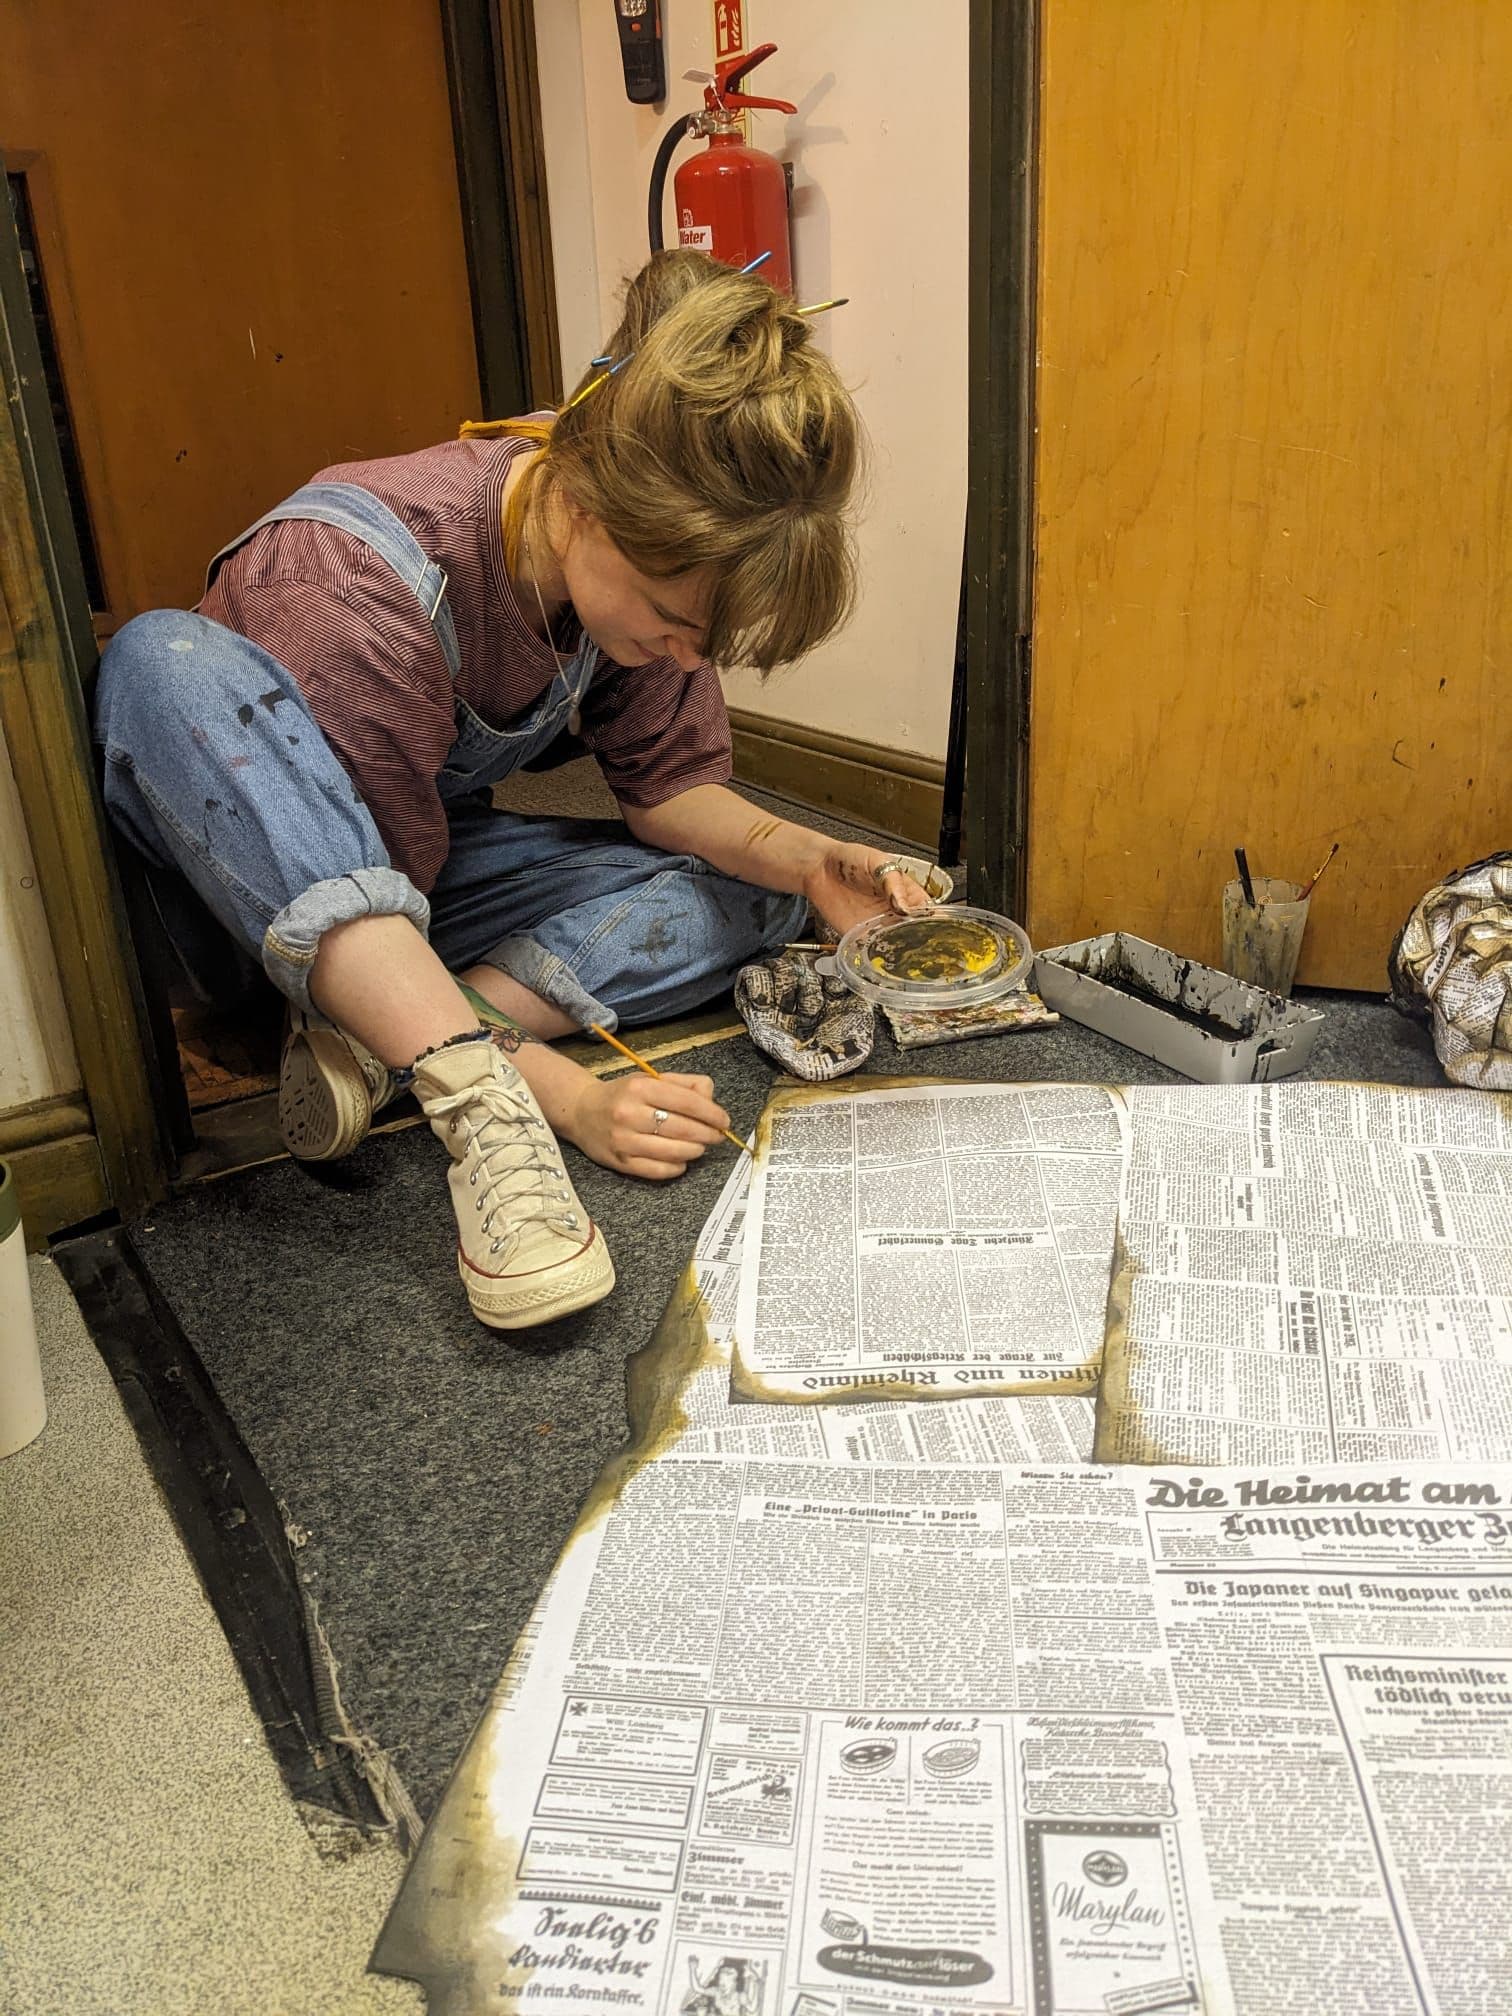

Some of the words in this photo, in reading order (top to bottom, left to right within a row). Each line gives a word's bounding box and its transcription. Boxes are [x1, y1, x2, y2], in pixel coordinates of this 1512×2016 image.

[717, 1234, 735, 1246] der
[712, 1247, 731, 1261] Aus
[882, 1352, 965, 1363] Kriegsschäden
[973, 1353, 991, 1362] der
[999, 1353, 1034, 1362] Frage
[1043, 1352, 1064, 1362] Zur
[802, 1369, 939, 1389] Rheinland
[954, 1369, 1004, 1384] und
[1146, 1477, 1228, 1507] Die
[1235, 1475, 1411, 1506] Heimat
[1422, 1482, 1501, 1505] am
[764, 1501, 791, 1512] Eine
[922, 1510, 936, 1519] in
[941, 1510, 978, 1521] Paris
[1220, 1511, 1475, 1546] Langenberger
[1474, 1512, 1512, 1546] Z
[1184, 1581, 1217, 1596] Die
[1223, 1581, 1310, 1597] Japaner
[1318, 1582, 1352, 1600] auf
[1358, 1583, 1460, 1602] Singapur
[1344, 1664, 1508, 1687] Reichsminister
[1375, 1686, 1451, 1707] tödlich
[844, 1715, 873, 1730] Wie
[874, 1716, 931, 1732] kommt
[688, 1851, 745, 1865] Zimmer
[710, 1894, 739, 1907] möbl.
[743, 1896, 784, 1910] Zimmer
[1052, 1881, 1166, 1936] Marylan
[831, 1949, 854, 1961] der
[855, 1950, 975, 1974] Schmutzauflöser
[527, 1982, 542, 1997] ist
[543, 1984, 564, 1998] ein
